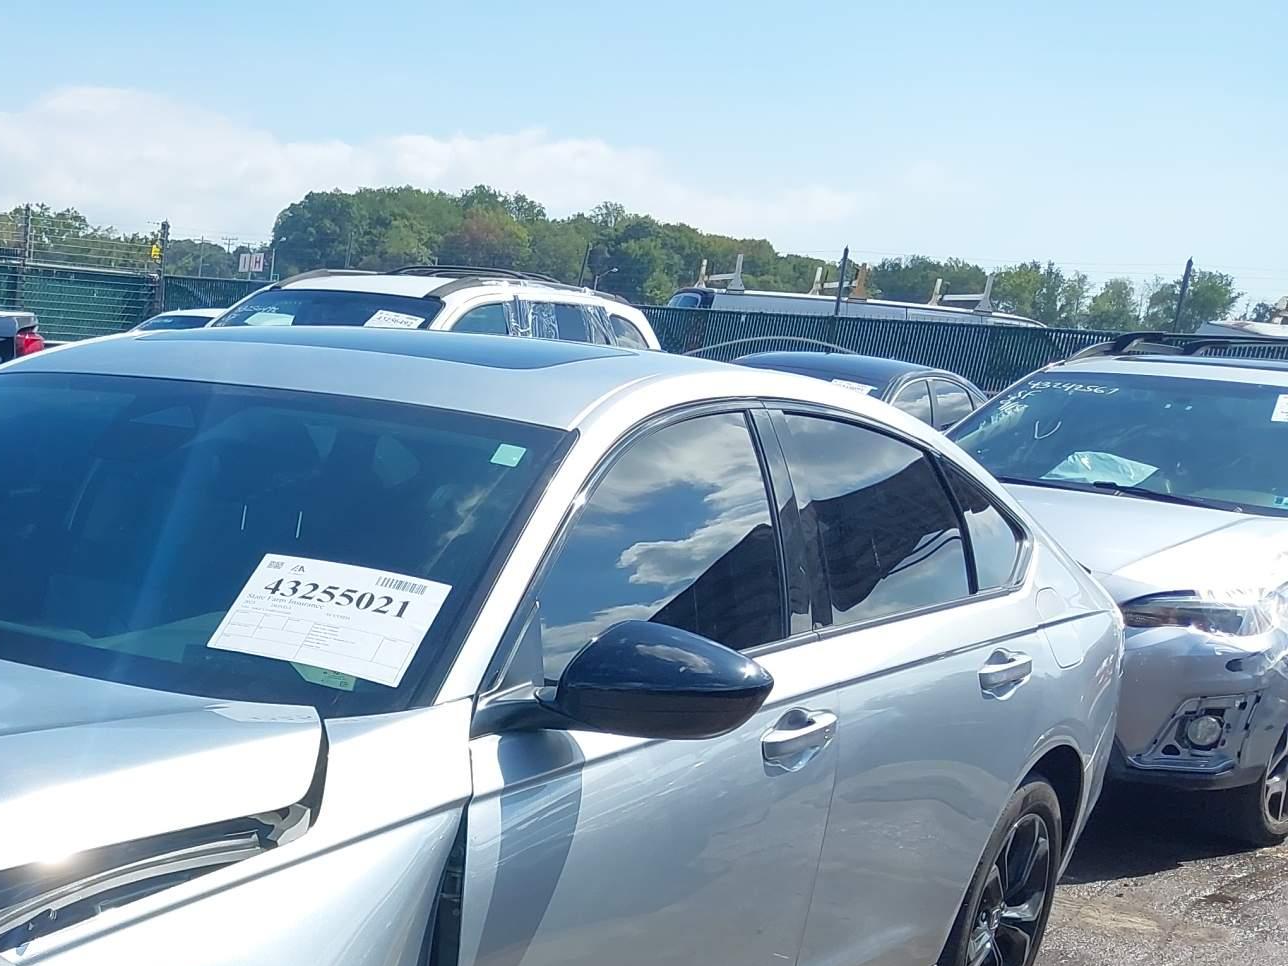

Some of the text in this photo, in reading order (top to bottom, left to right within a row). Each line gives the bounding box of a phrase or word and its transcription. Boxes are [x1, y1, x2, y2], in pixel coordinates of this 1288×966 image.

[247, 592, 266, 601] State
[267, 595, 287, 604] Farm
[263, 576, 412, 619] 43255021
